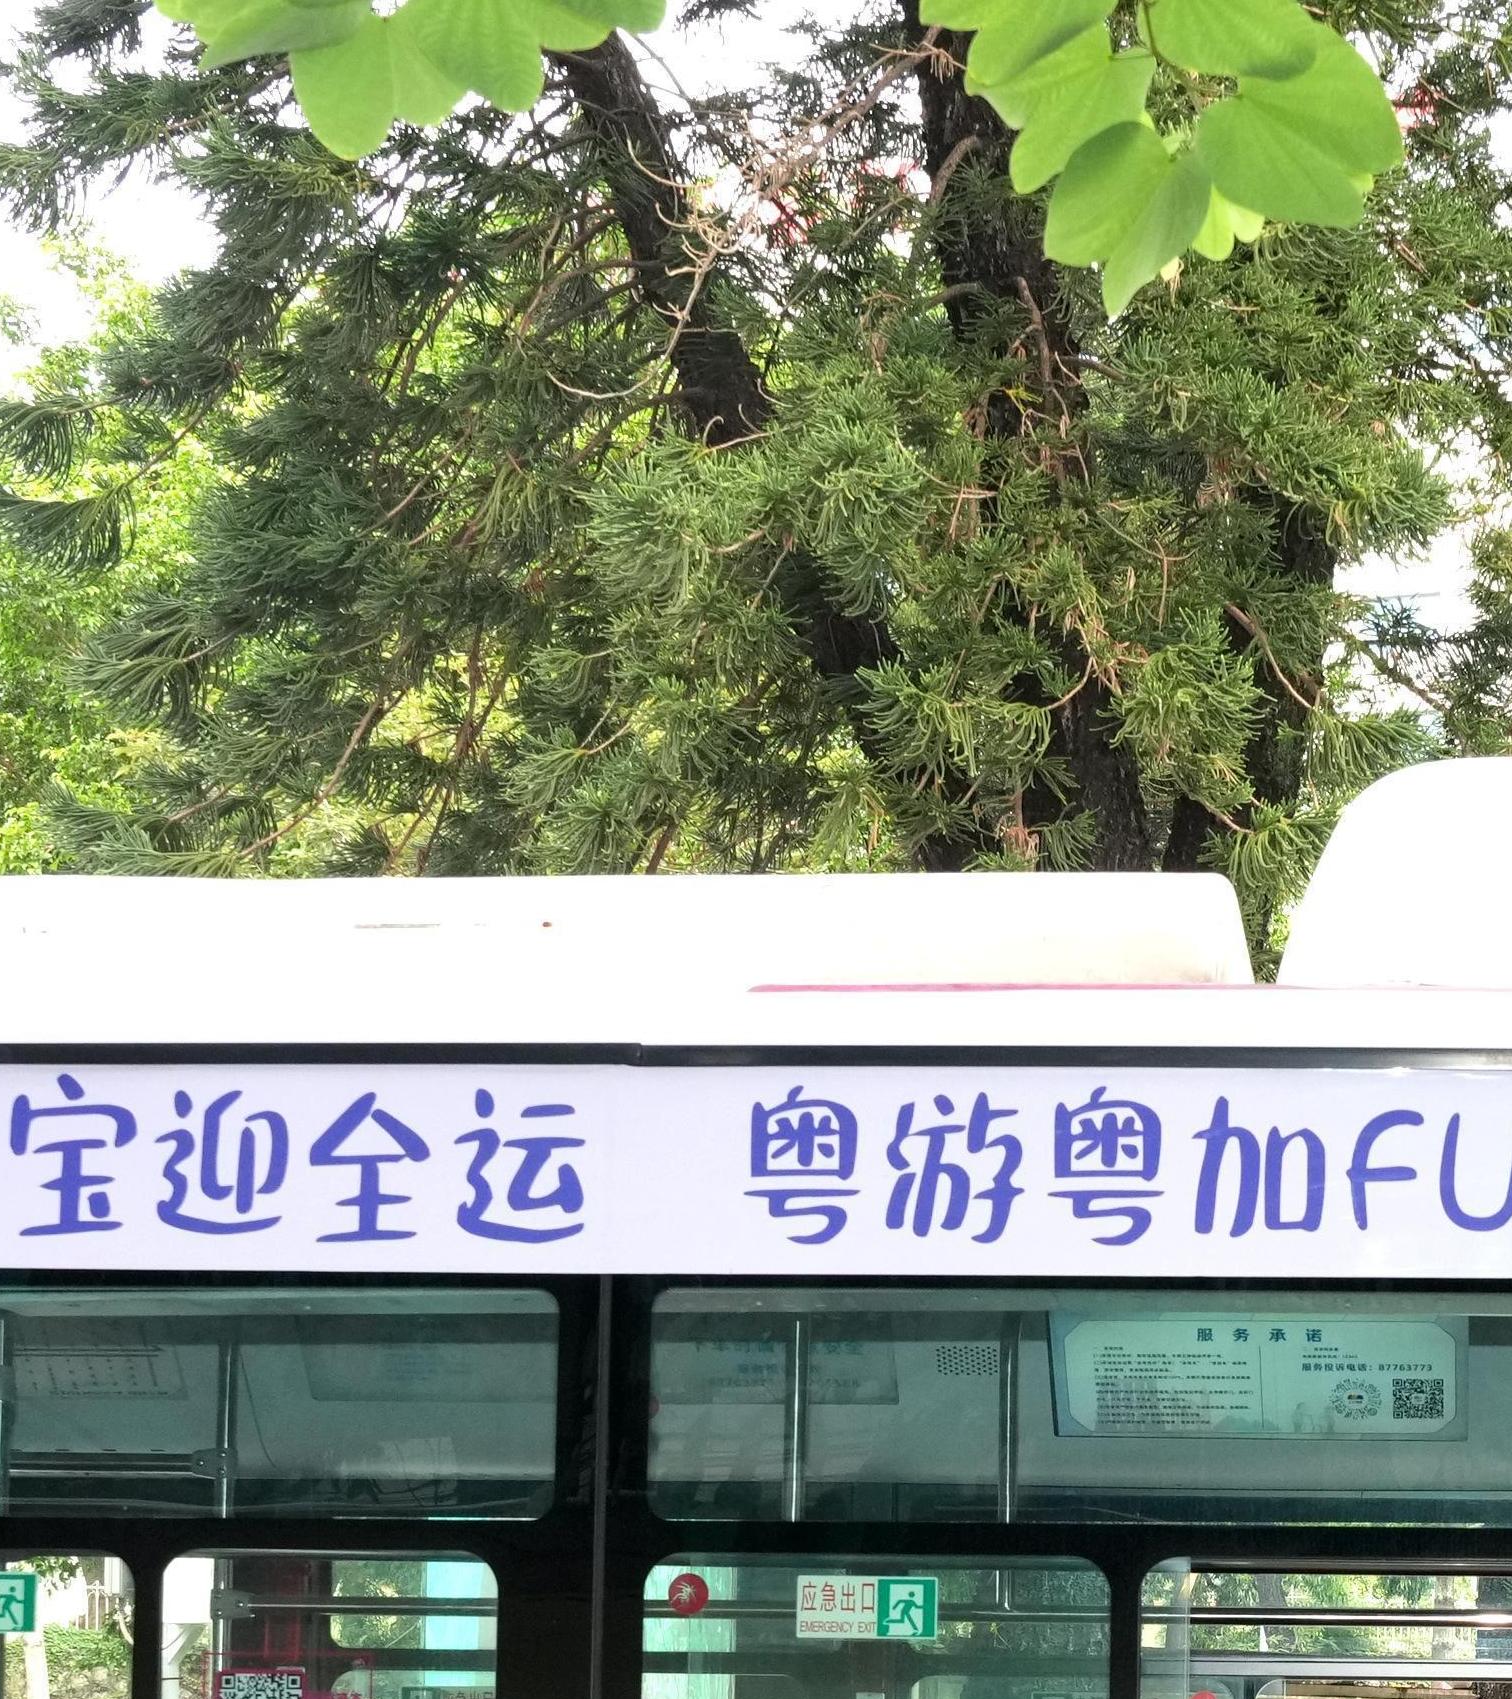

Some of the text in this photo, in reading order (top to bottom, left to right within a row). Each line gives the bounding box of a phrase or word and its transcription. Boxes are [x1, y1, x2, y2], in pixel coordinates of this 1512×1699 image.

[1196, 1327, 1324, 1343] 服务承诺
[801, 1581, 875, 1613] 应急出口
[799, 1621, 876, 1633] EMERGENCY EXIT
